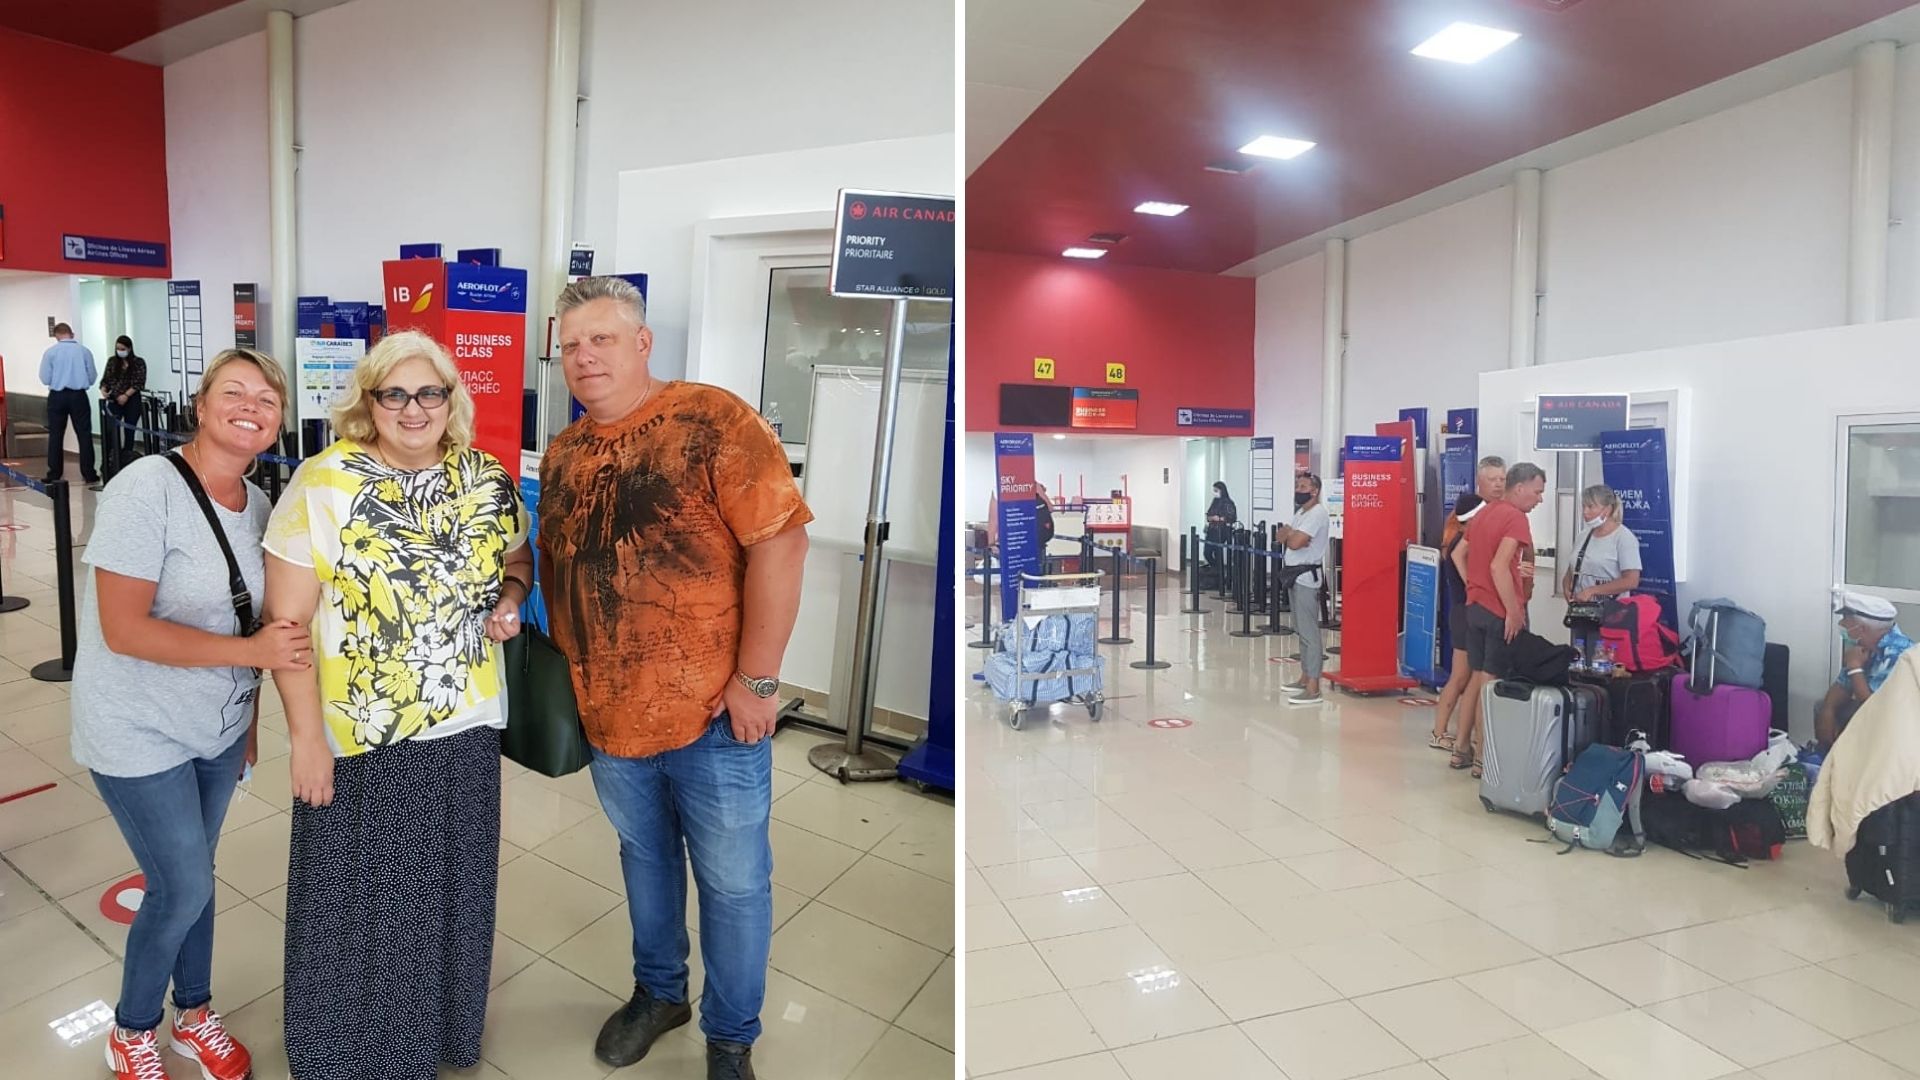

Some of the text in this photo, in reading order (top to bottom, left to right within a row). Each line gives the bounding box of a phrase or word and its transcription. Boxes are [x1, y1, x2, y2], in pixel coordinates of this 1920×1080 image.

[872, 206, 899, 219] AIR
[846, 235, 886, 246] PRIORITY
[845, 248, 894, 260] PRIORITAIRE
[457, 281, 499, 293] AEROFLOT
[855, 284, 946, 295] STAR ALLIANCE GOLD
[393, 286, 410, 303] IB
[456, 334, 512, 347] BUSINESS
[456, 346, 493, 358] CLASS
[1037, 362, 1052, 375] 47
[1109, 368, 1123, 379] 48
[1578, 401, 1621, 409] CANADA
[1000, 476, 1015, 484] SKY
[1351, 473, 1392, 481] BUSINESS
[1001, 484, 1033, 493] PRIORITY
[1613, 489, 1643, 500] РИЕМ
